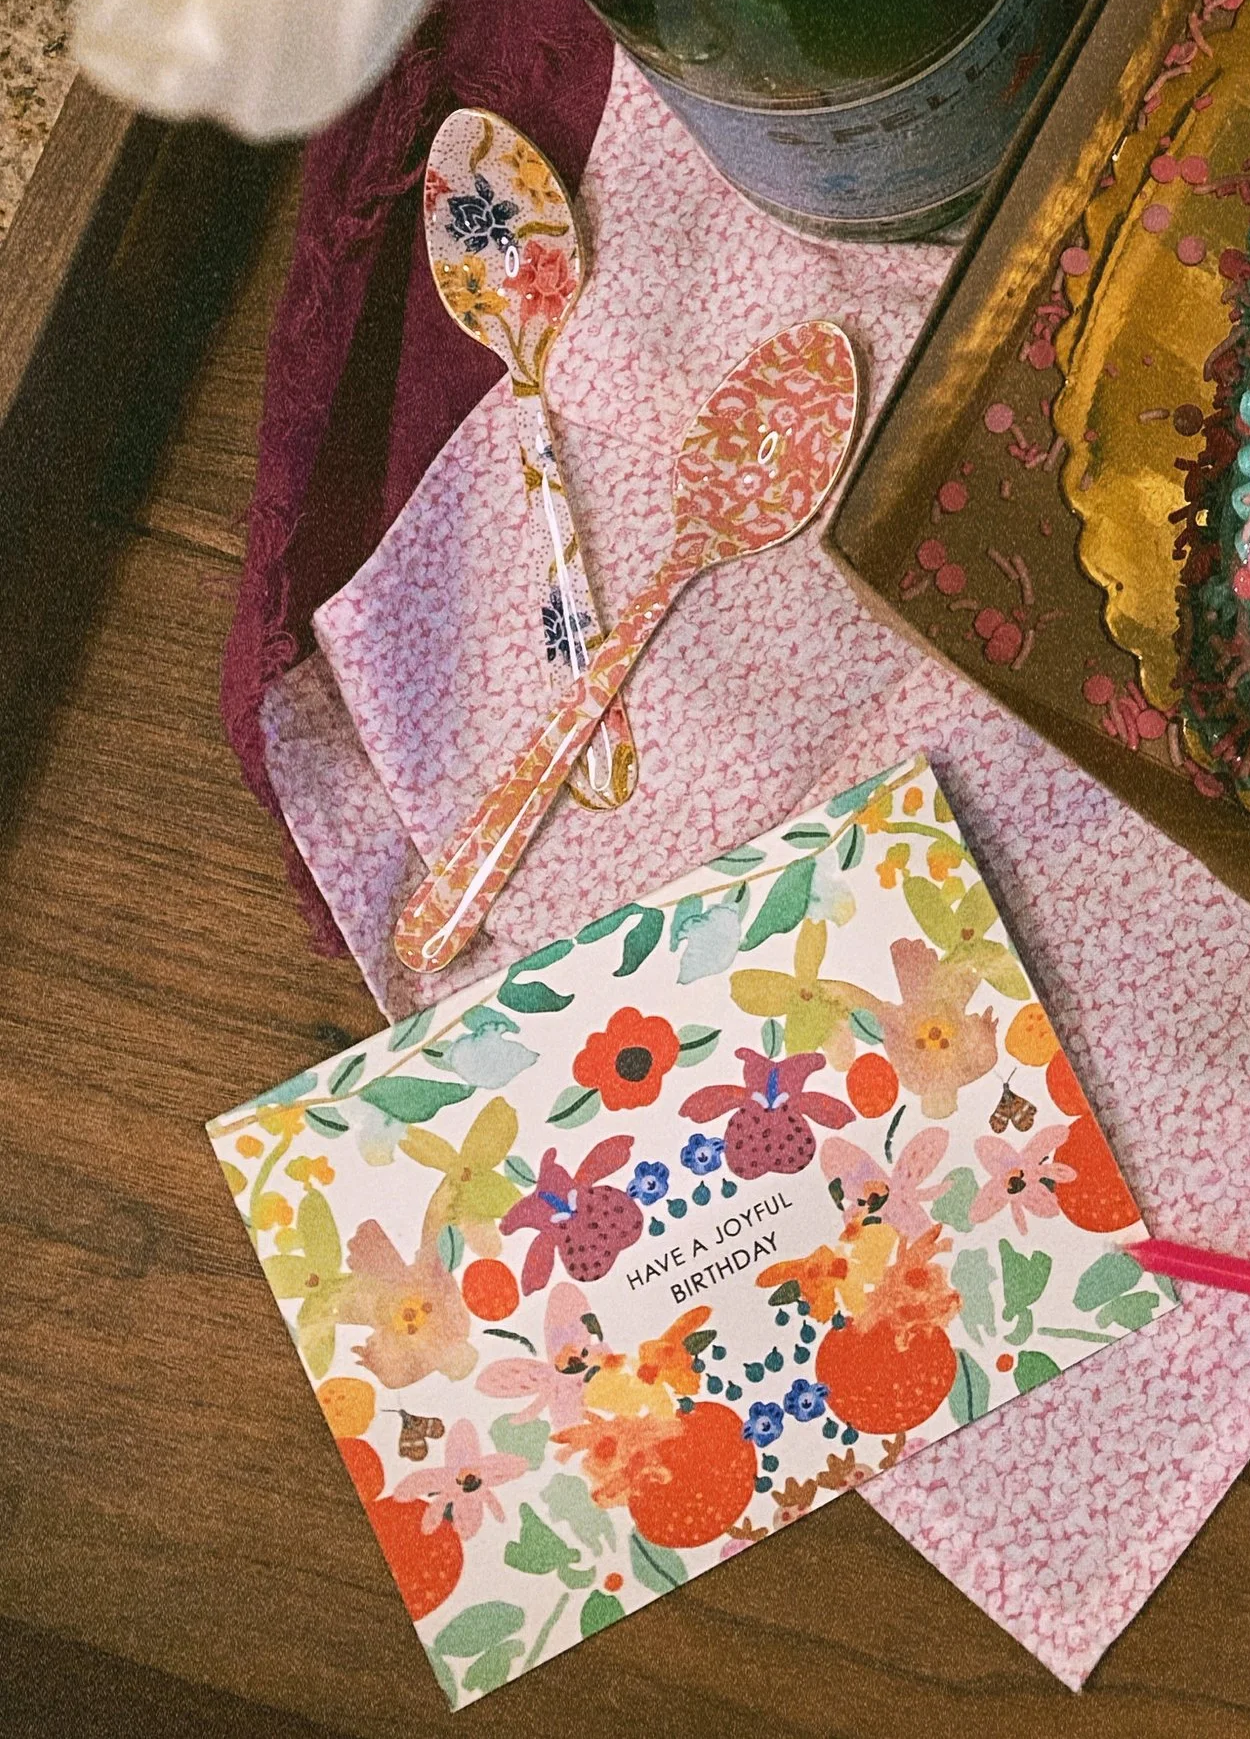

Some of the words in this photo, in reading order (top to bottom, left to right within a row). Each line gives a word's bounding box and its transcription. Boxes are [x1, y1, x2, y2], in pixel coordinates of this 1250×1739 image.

[626, 1246, 686, 1291] HAVE
[692, 1238, 708, 1258] A
[715, 1192, 793, 1245] JOYFUL
[670, 1231, 778, 1304] BIRTHDAY
